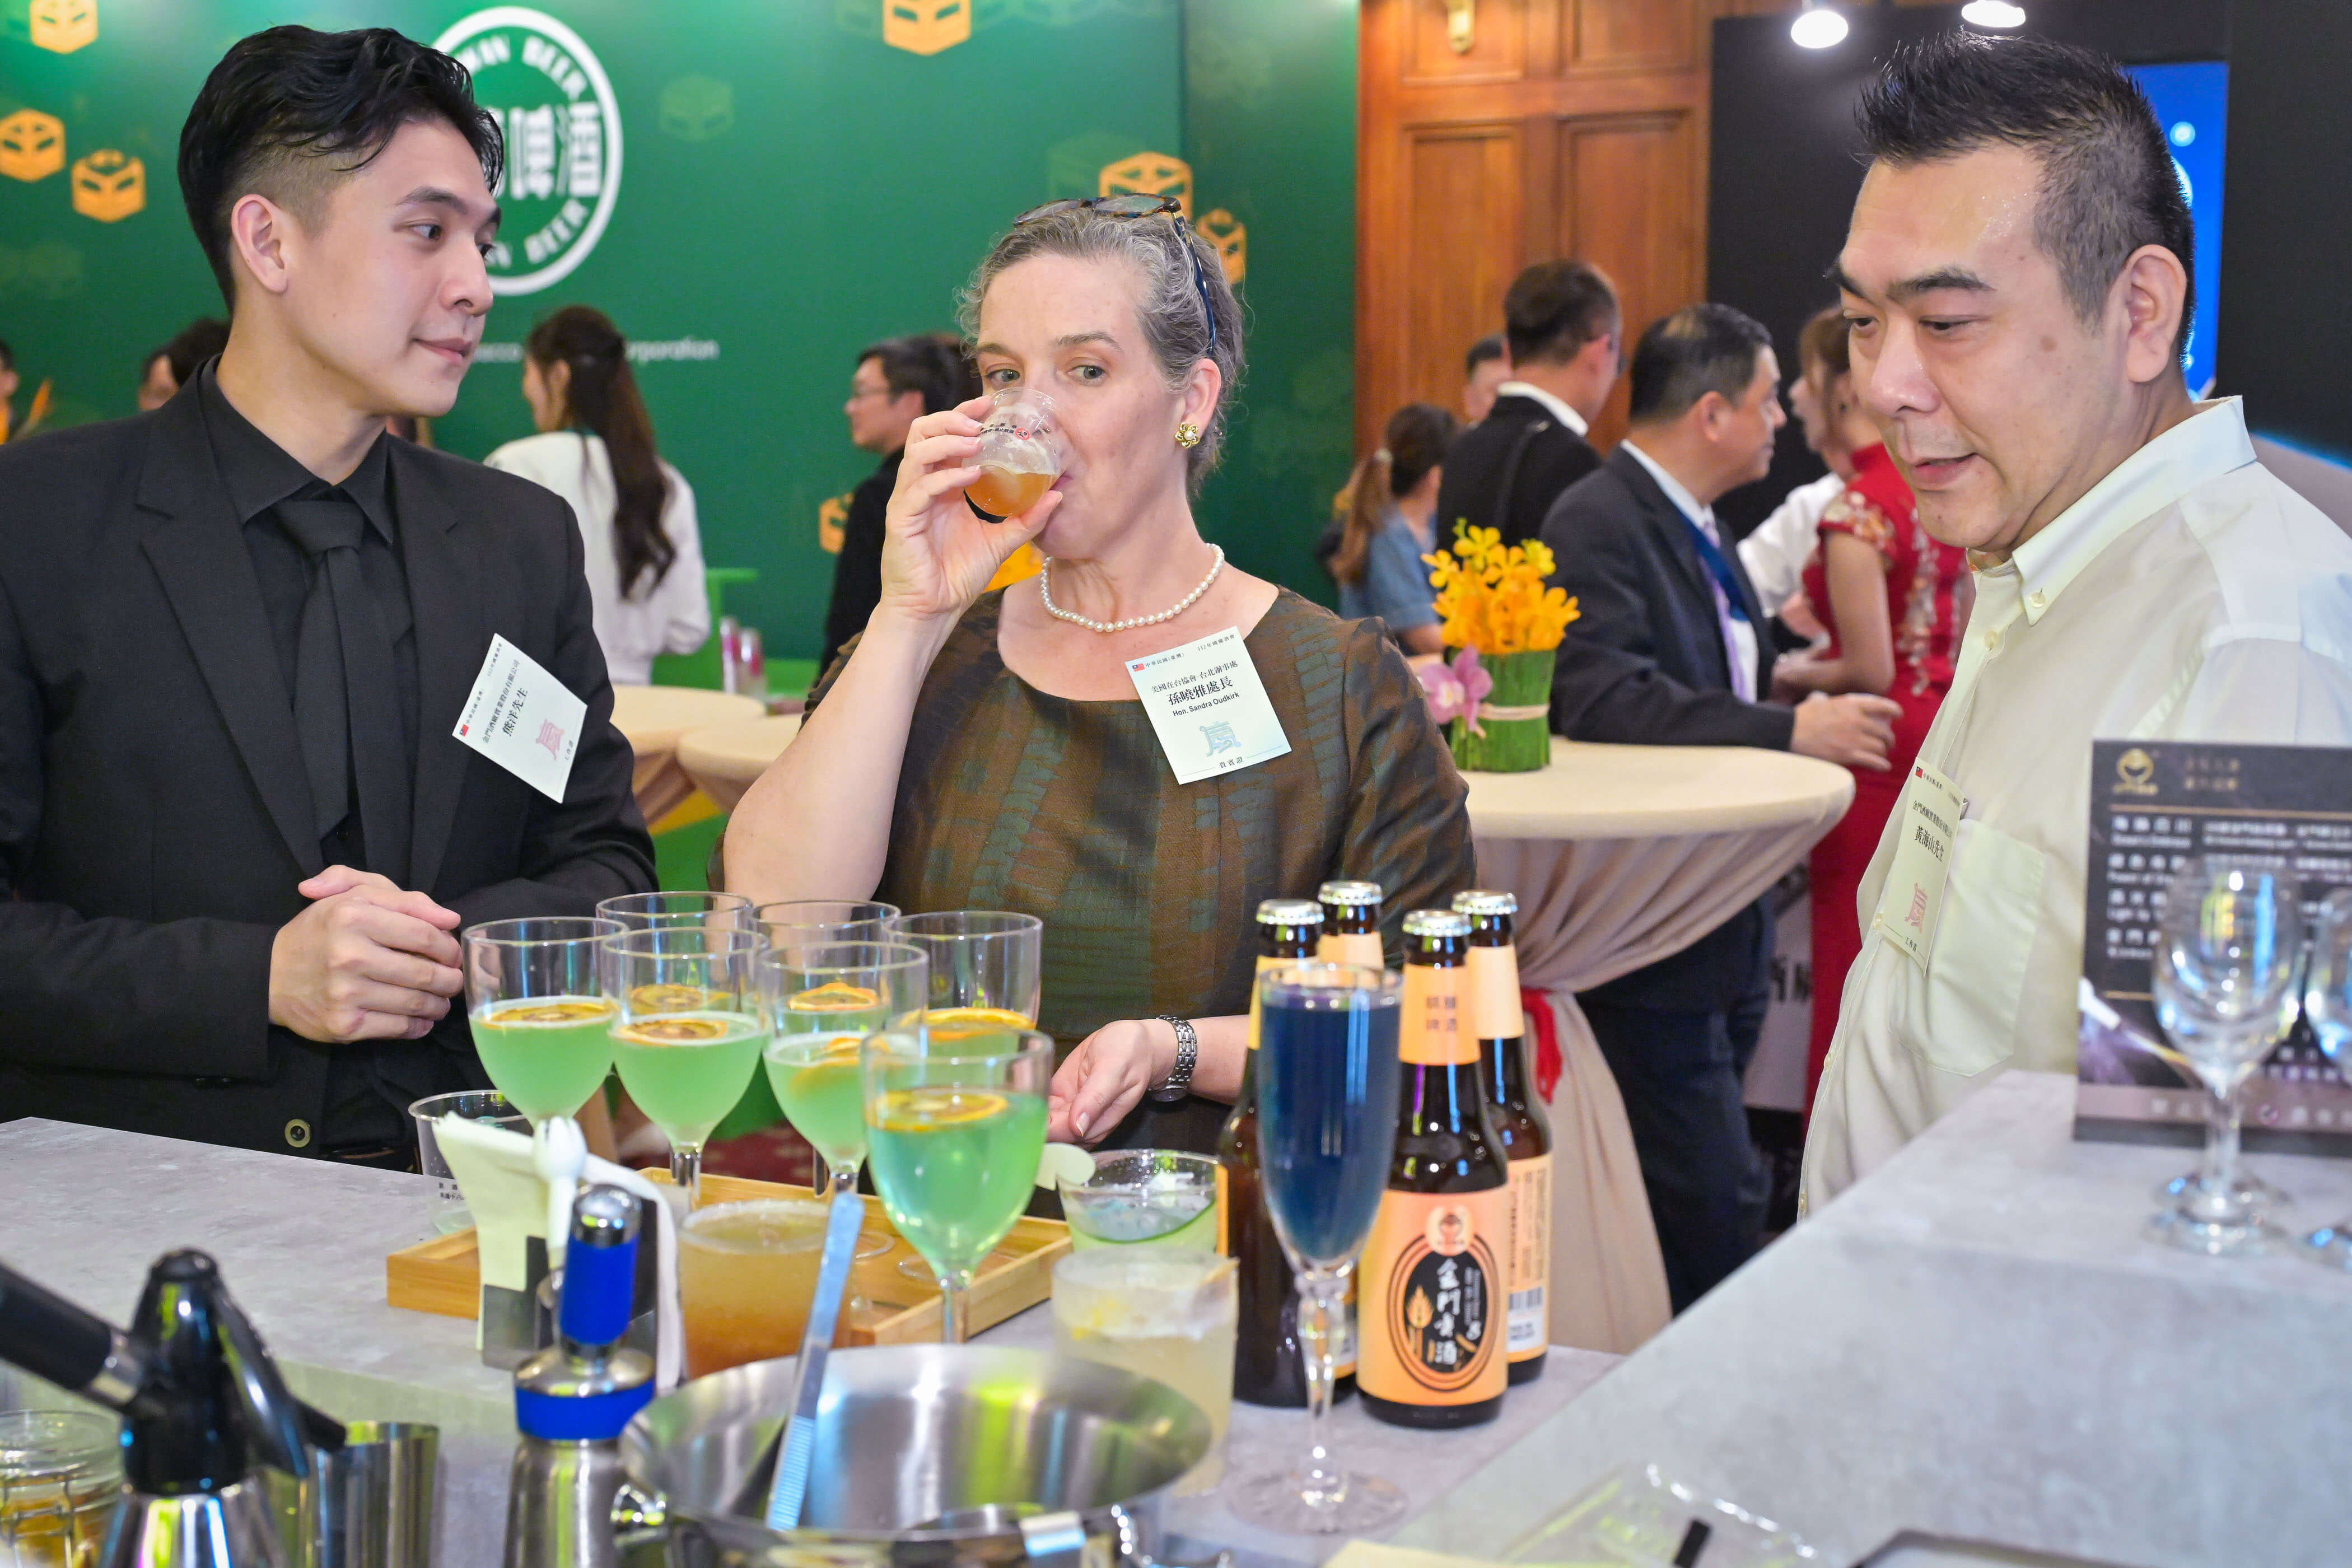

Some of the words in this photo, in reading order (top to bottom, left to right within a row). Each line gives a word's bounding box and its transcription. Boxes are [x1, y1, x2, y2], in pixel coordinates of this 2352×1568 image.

[1168, 676, 1234, 706] 孫曉雅處長
[1173, 708, 1189, 717] Hon.
[1189, 700, 1212, 712] Sandra
[1213, 692, 1239, 705] Oudkirk
[502, 687, 528, 737] 熊洋先生
[1914, 825, 1945, 862] 黃海山先生
